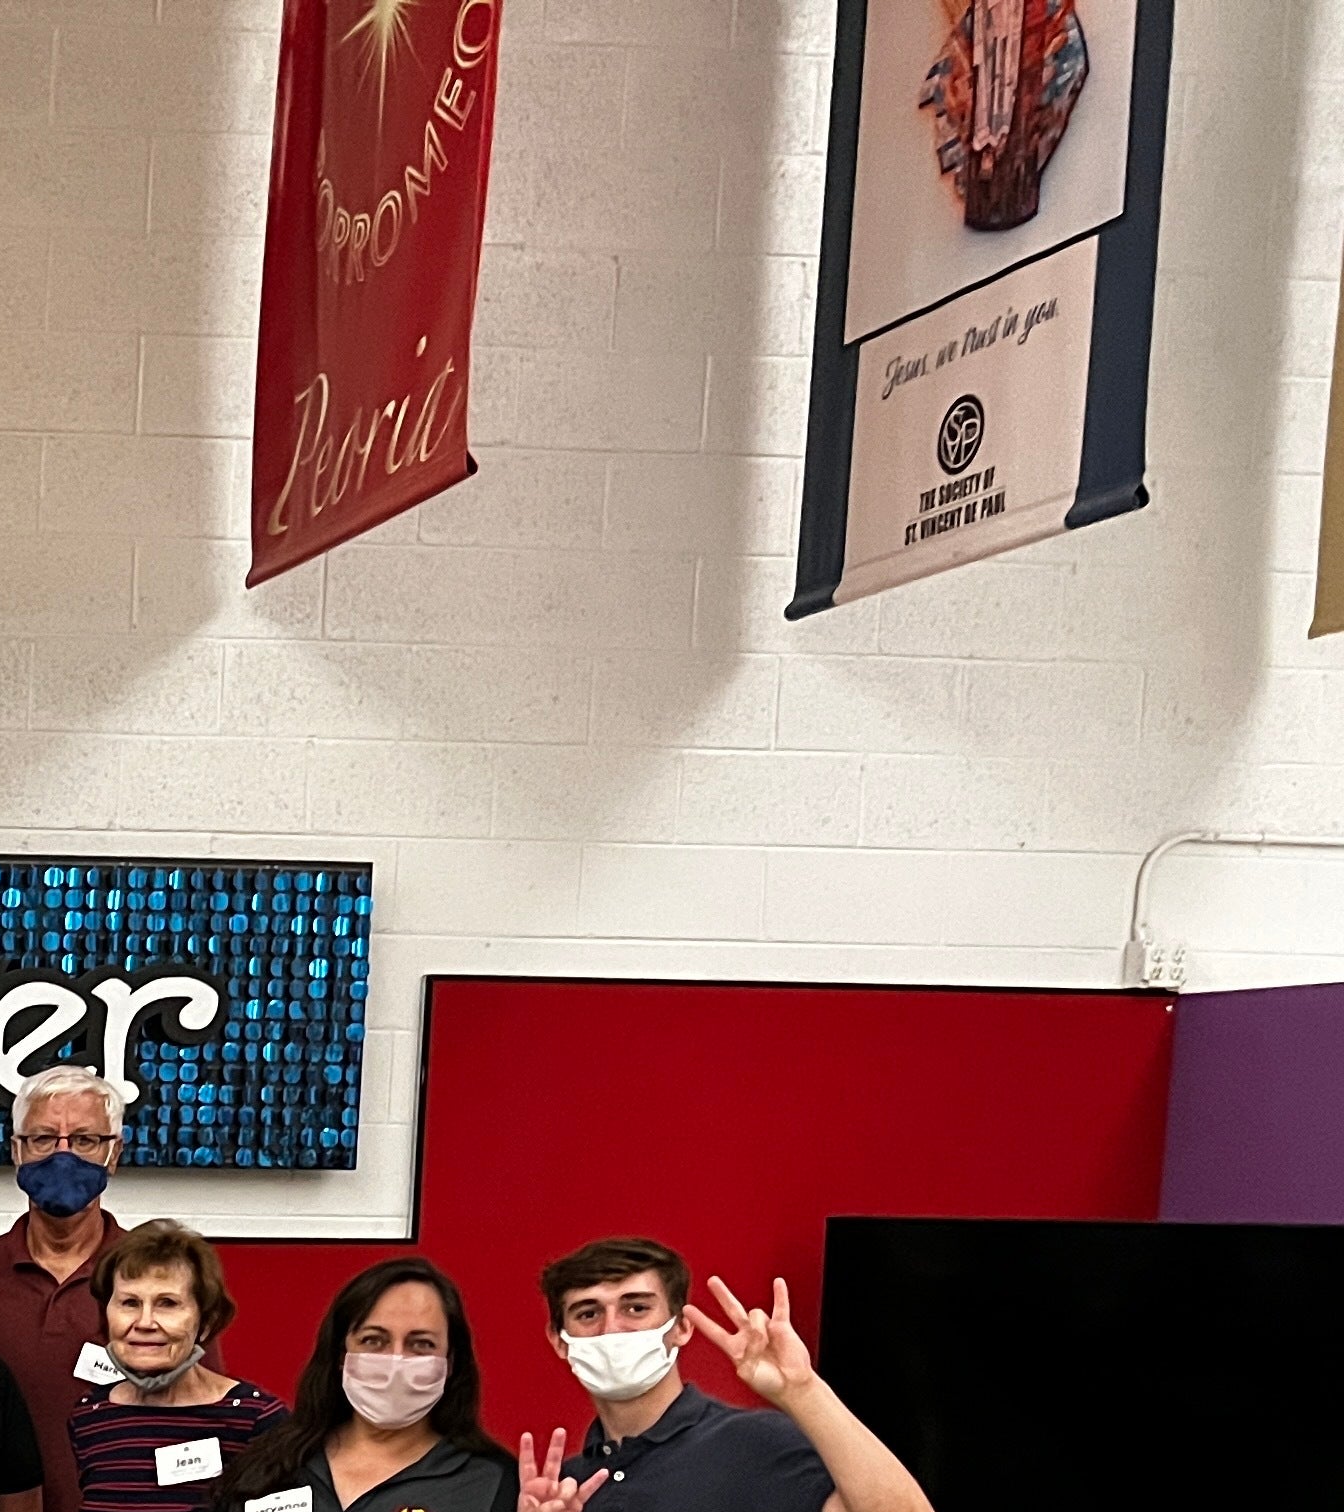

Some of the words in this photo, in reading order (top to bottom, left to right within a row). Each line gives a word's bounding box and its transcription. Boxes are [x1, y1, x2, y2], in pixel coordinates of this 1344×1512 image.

[935, 342, 955, 369] we
[961, 321, 999, 357] trust
[1002, 306, 1019, 338] in
[268, 336, 463, 536] Peoria
[919, 489, 936, 514] THE
[939, 472, 983, 507] SOCIETY
[982, 466, 996, 490] OF
[920, 506, 963, 540] VINCENT
[980, 490, 1006, 520] PAUL
[176, 1456, 202, 1467] Jean
